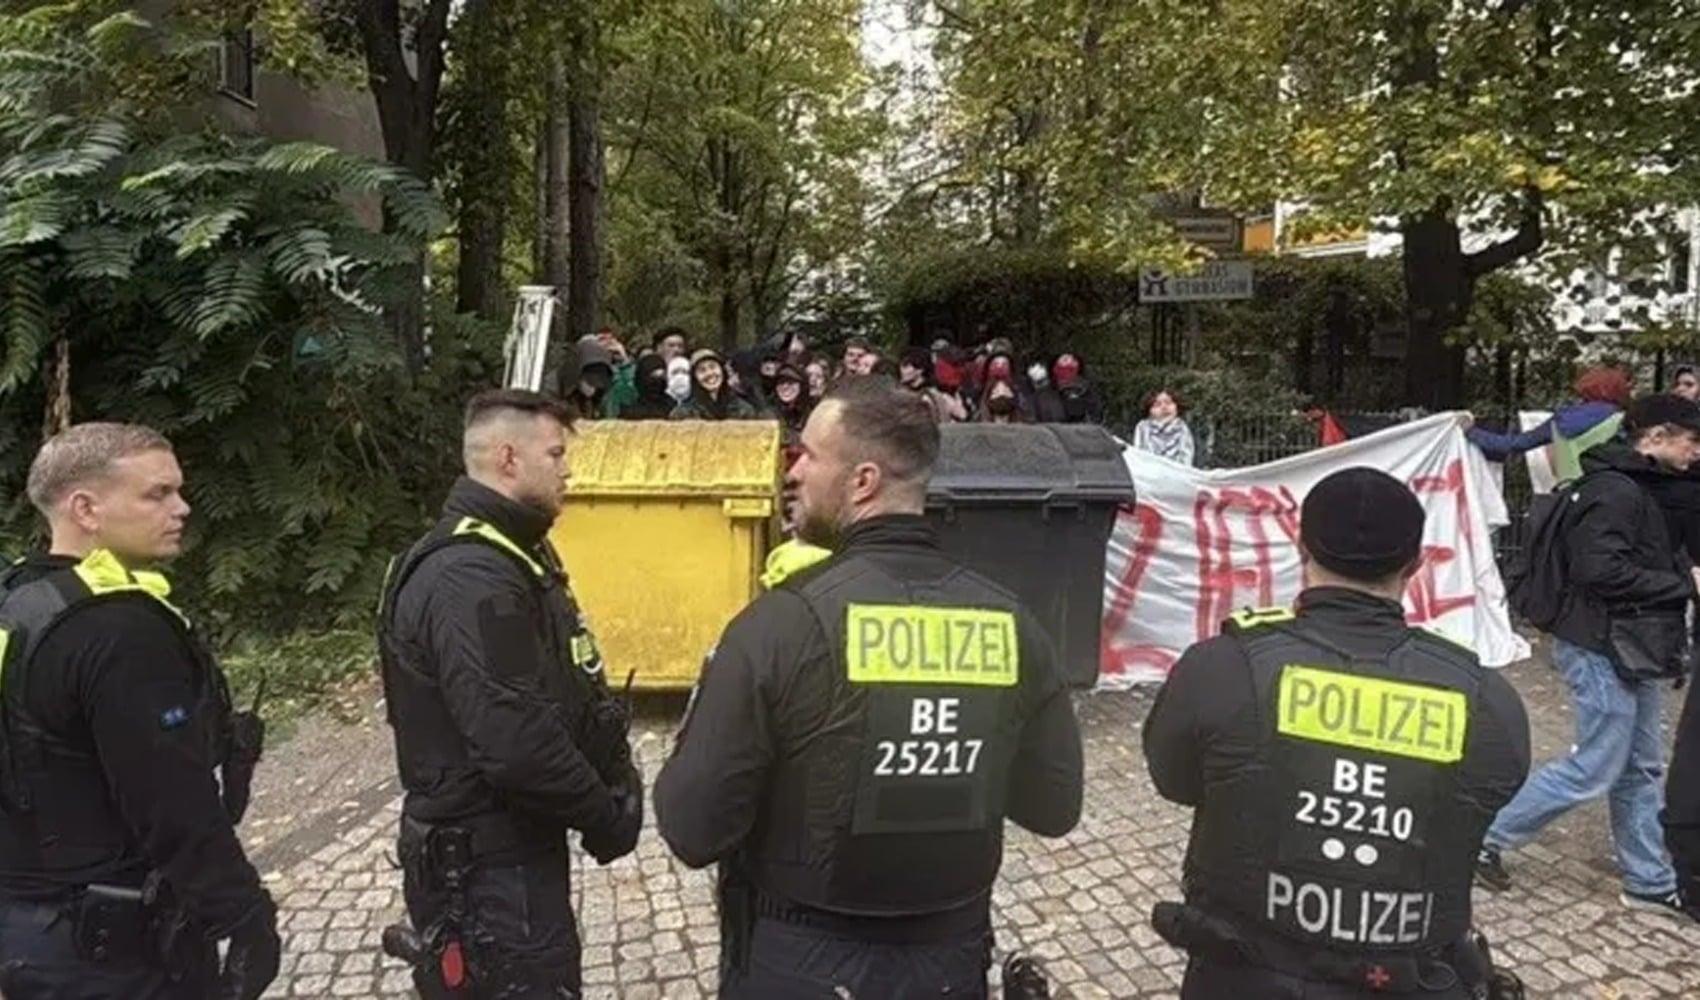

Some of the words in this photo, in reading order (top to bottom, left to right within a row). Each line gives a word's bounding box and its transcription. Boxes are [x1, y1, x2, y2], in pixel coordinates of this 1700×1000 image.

[858, 617, 1010, 671] POLIZEI
[910, 697, 960, 735] BE
[1287, 677, 1456, 751] POLIZEI
[873, 740, 983, 776] 25217
[1332, 757, 1388, 799] BE
[1295, 791, 1414, 841] 25210
[1266, 871, 1435, 944] POLIZEI
